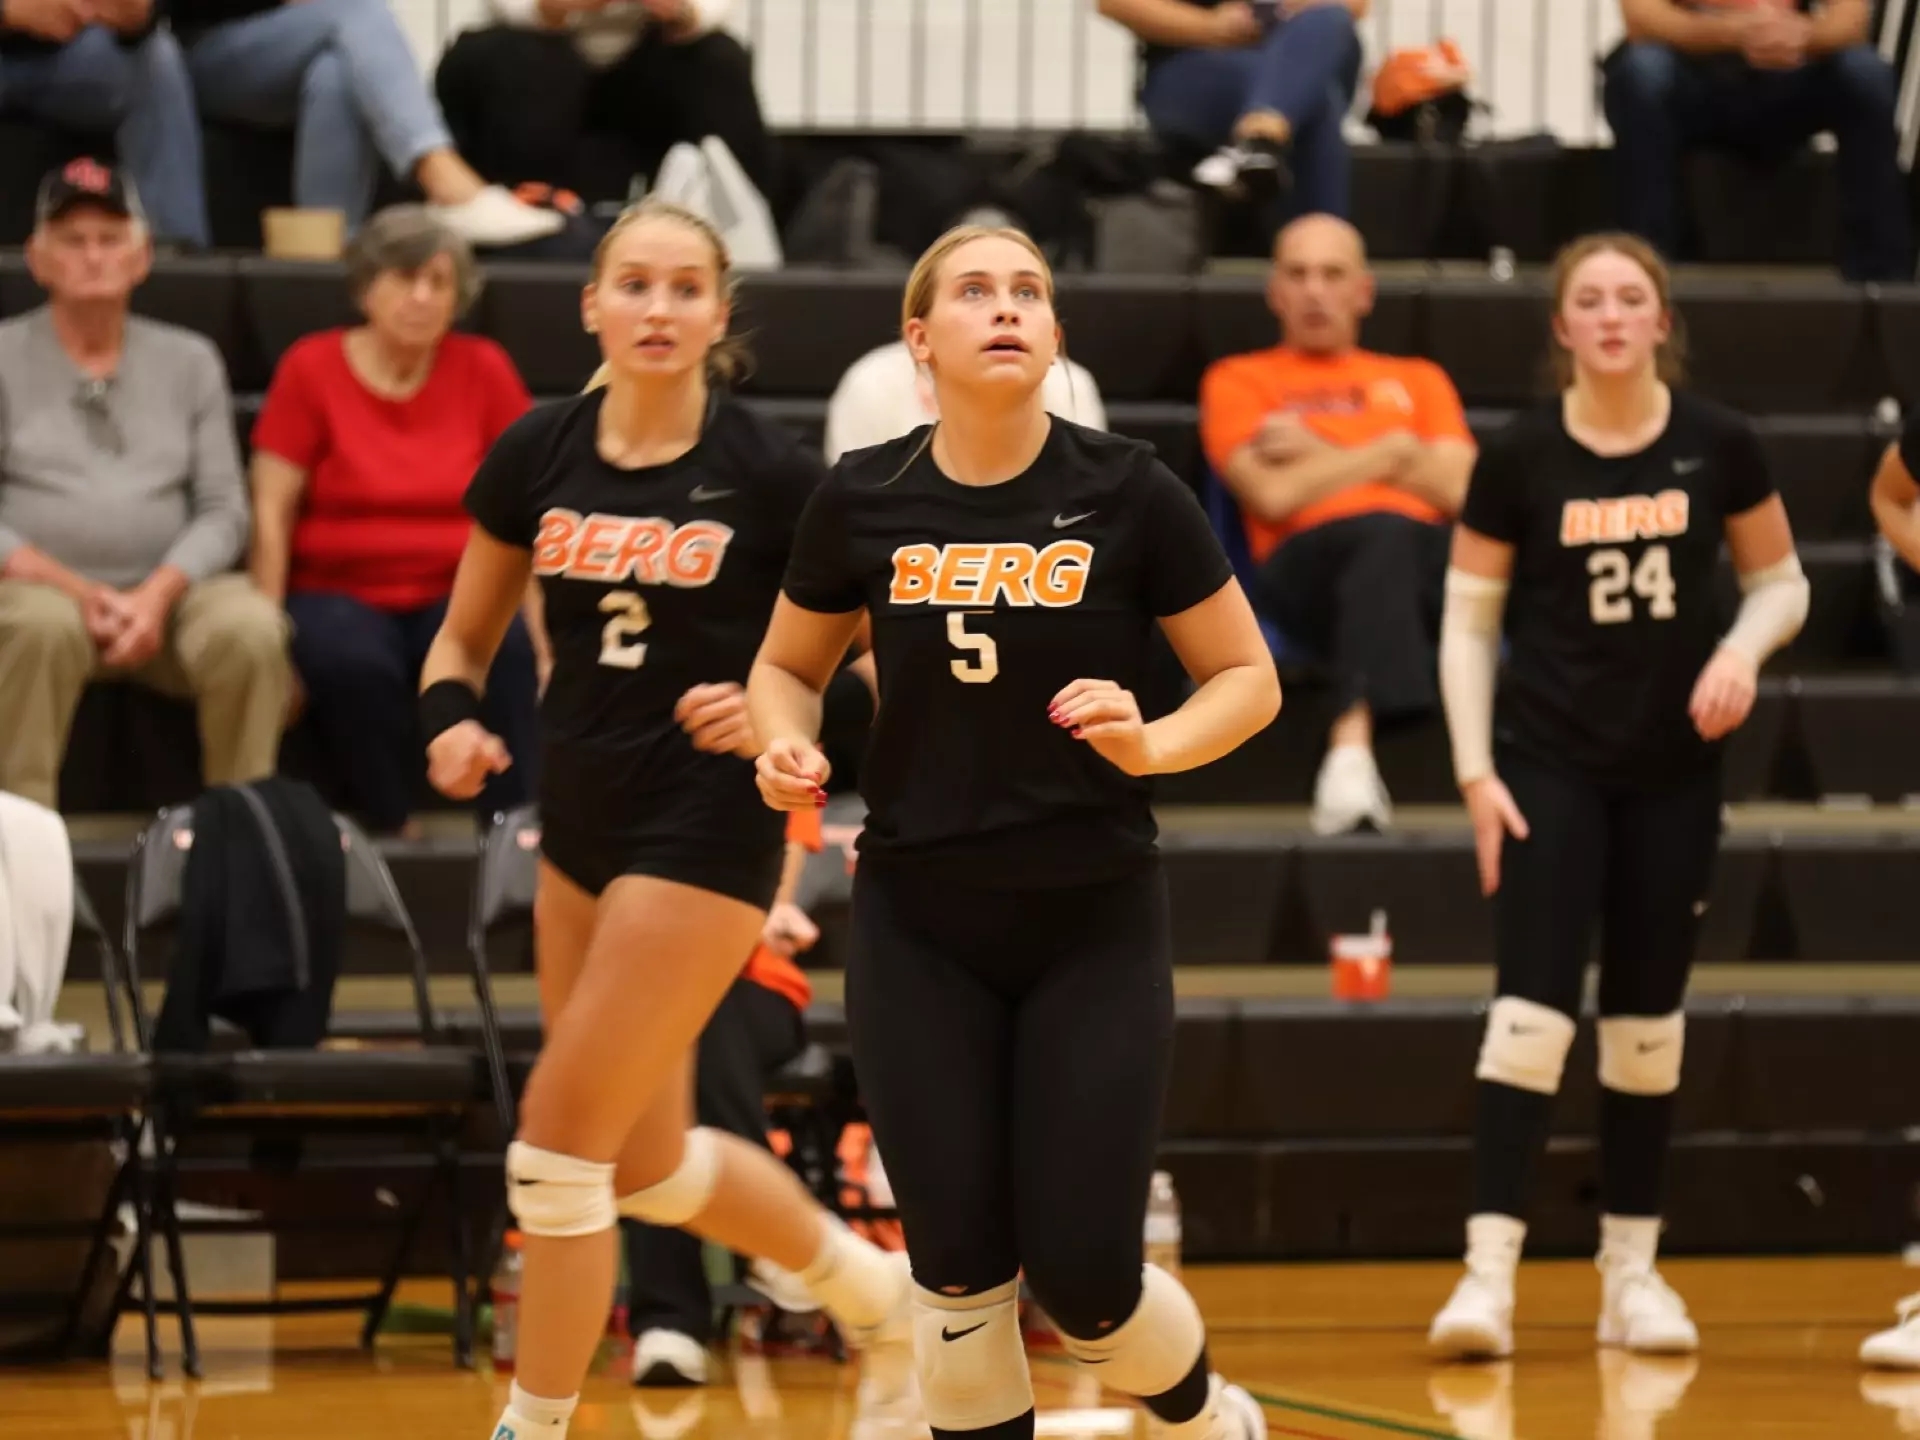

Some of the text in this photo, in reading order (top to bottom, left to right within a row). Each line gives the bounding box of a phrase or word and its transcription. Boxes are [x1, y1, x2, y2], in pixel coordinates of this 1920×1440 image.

[533, 507, 735, 588] BERG
[889, 540, 1095, 607] BERG
[1586, 545, 1677, 624] 24
[598, 590, 652, 670] 2
[947, 610, 999, 683] 5
